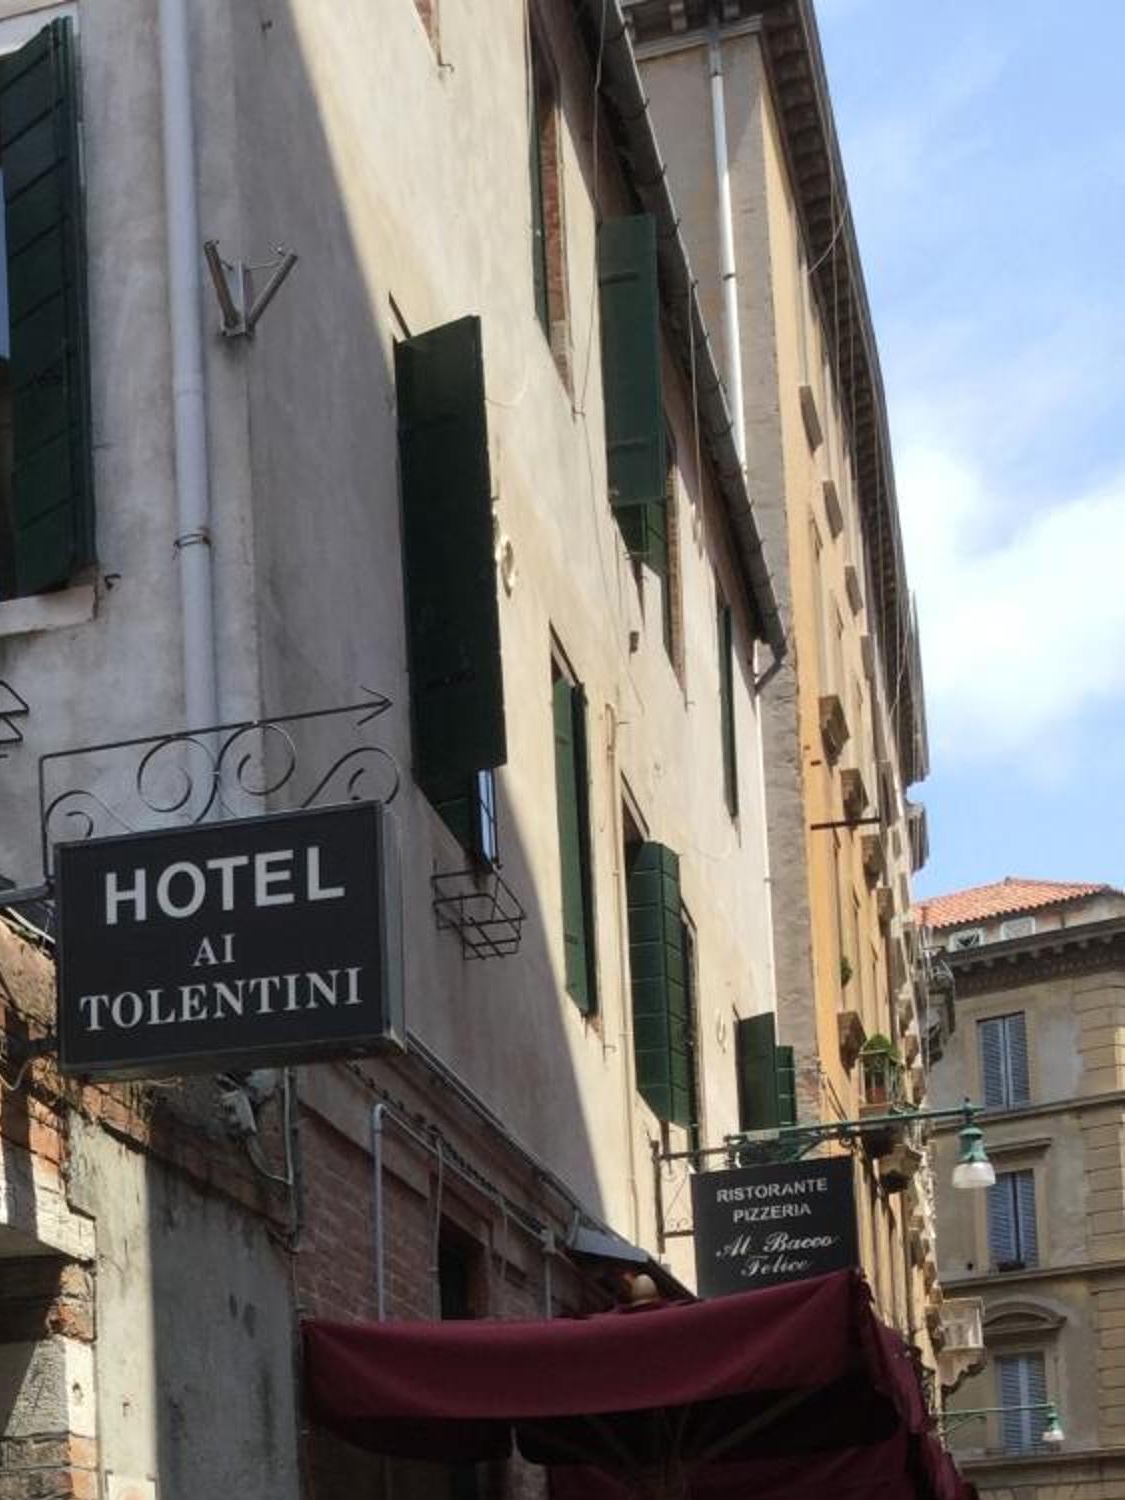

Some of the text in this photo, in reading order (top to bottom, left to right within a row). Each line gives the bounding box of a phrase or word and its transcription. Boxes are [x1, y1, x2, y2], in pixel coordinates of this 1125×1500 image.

[105, 845, 346, 925] HOTEL
[191, 933, 236, 967] AI
[78, 966, 364, 1032] TOLENTINI
[716, 1177, 828, 1203] RISTORANTE
[732, 1203, 812, 1223] PIZZERIA
[715, 1231, 836, 1258] Al Bacco
[740, 1254, 810, 1278] Felice
